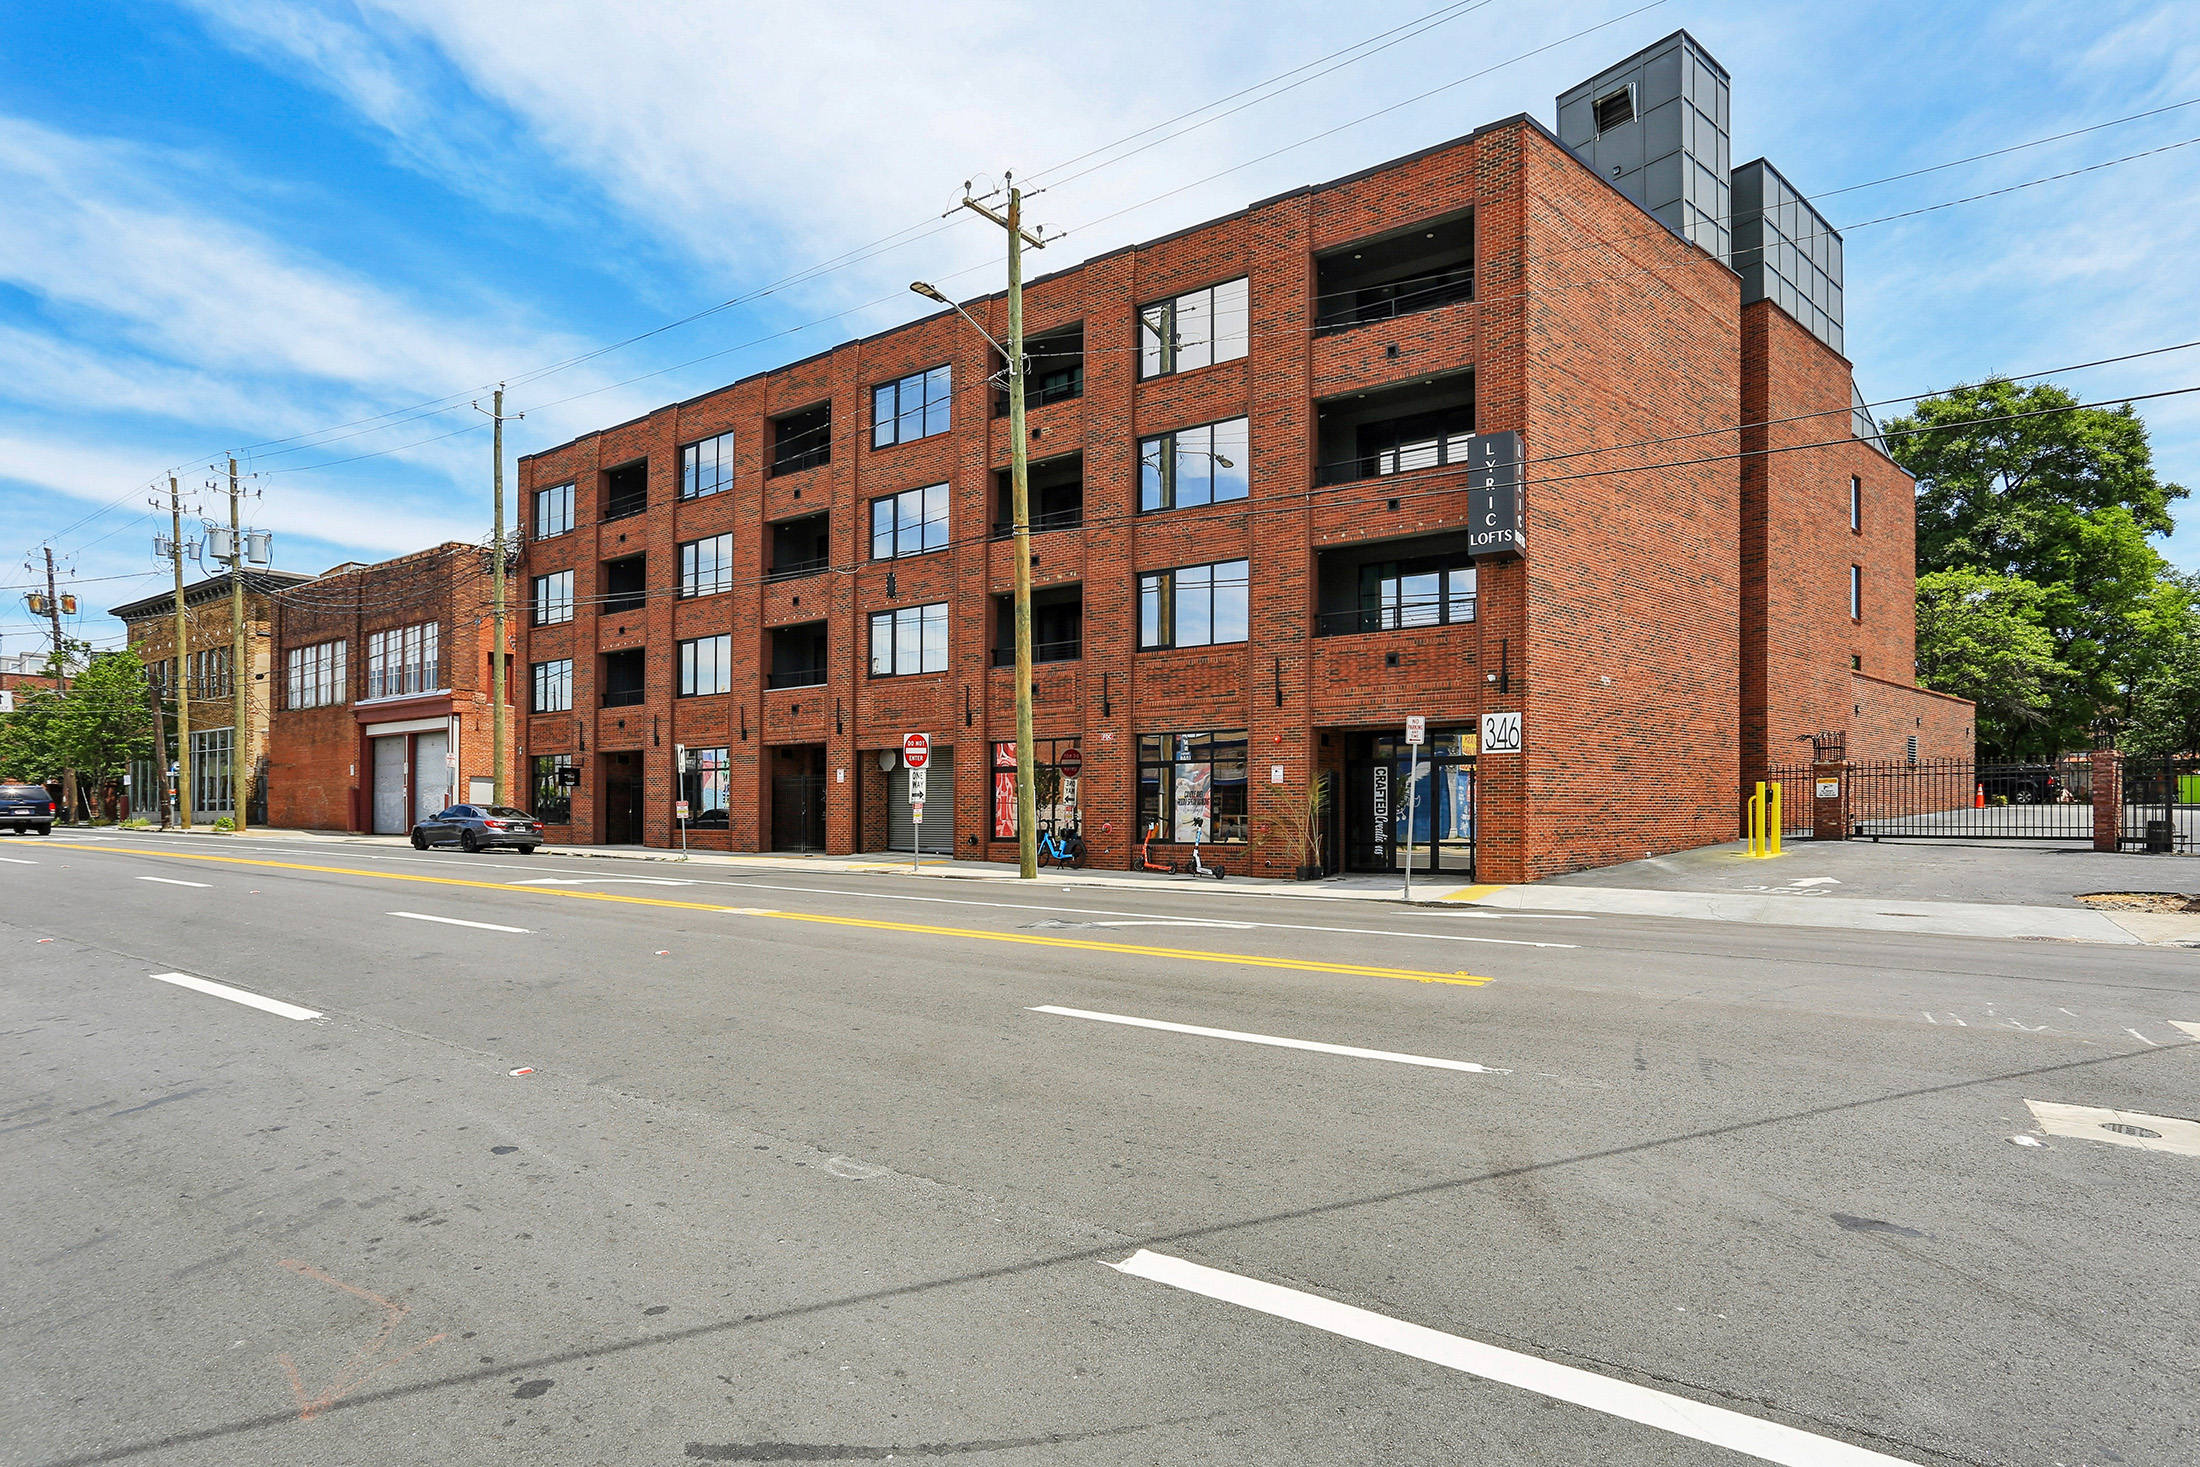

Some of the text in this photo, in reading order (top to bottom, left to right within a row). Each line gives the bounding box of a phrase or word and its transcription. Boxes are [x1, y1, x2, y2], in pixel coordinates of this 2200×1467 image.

[1485, 442, 1497, 527] LYRIC
[1470, 528, 1513, 546] LOFTS
[1485, 716, 1520, 749] 346
[911, 771, 924, 780] ONE
[911, 781, 924, 789] WAY
[1375, 768, 1387, 815] CRAFTED
